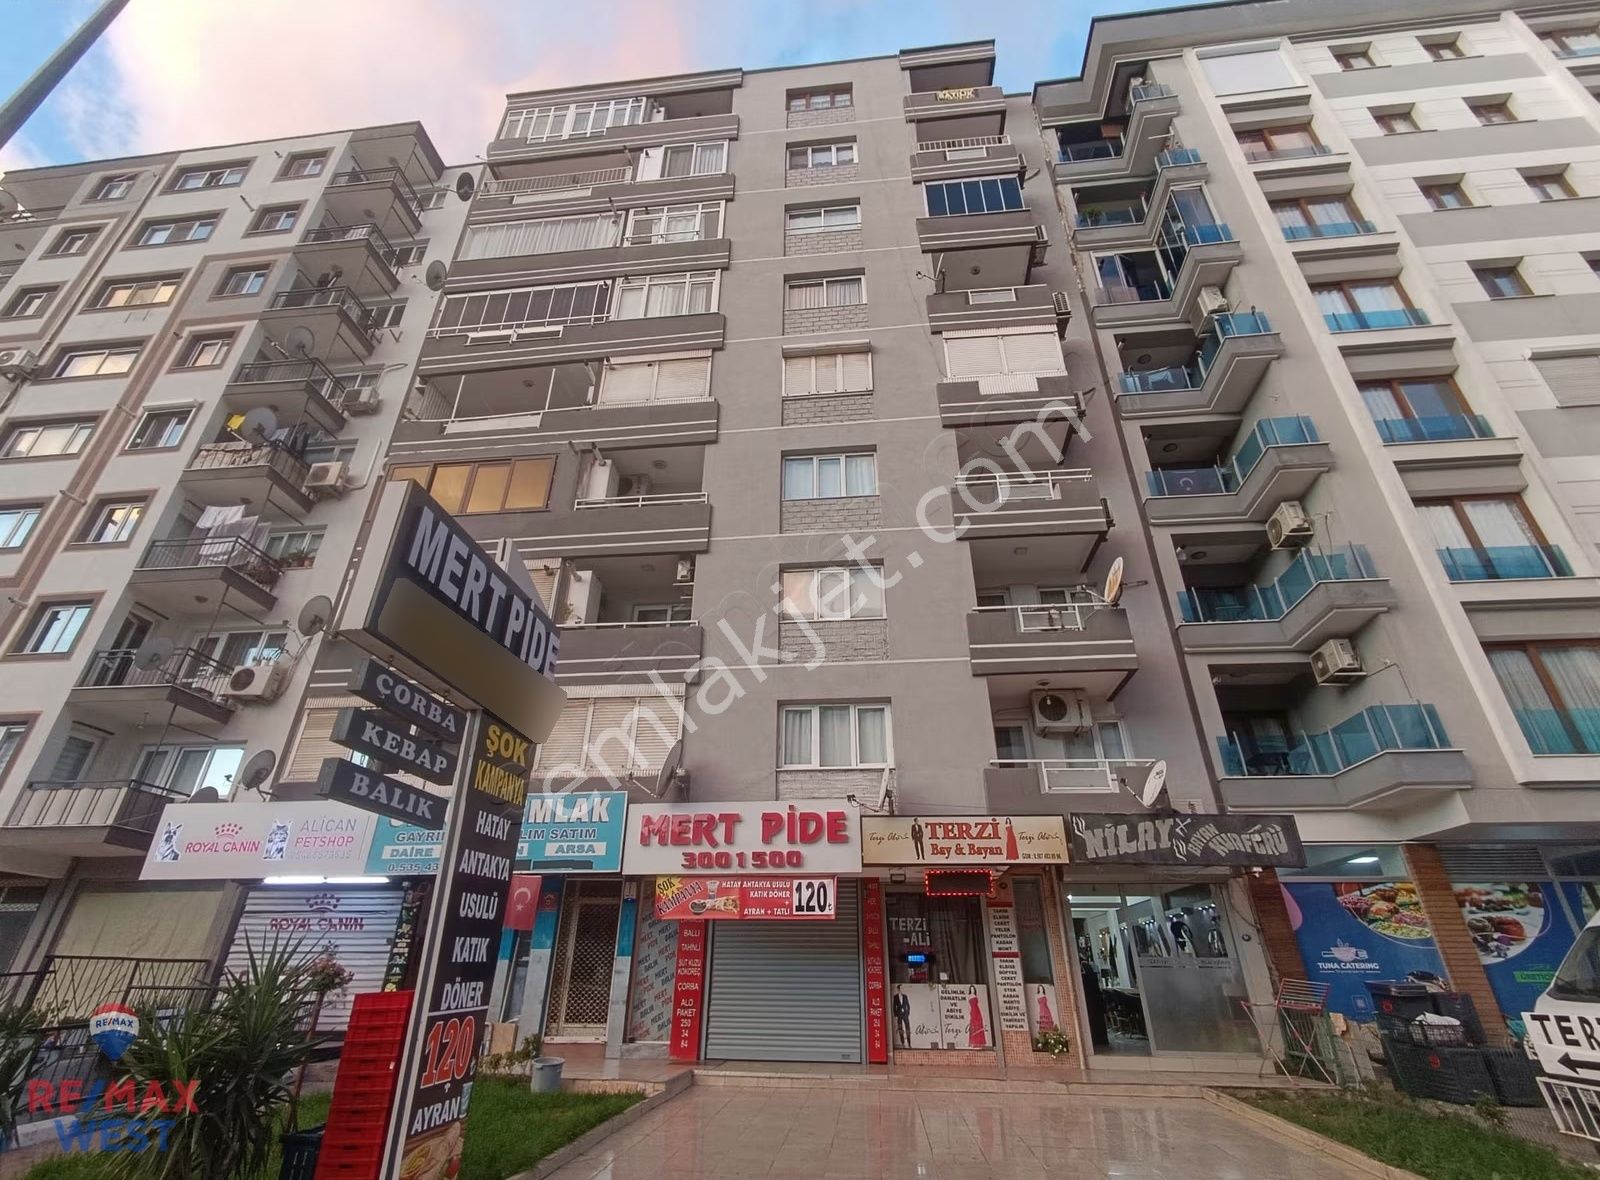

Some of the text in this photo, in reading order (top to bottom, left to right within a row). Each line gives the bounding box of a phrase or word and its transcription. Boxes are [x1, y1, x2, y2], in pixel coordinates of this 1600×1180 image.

[408, 505, 507, 632] MERT
[376, 673, 456, 732] ÇORBA
[361, 721, 447, 773] KEBAP
[486, 724, 528, 767] ŞOK
[474, 759, 525, 806] KAMPANYA
[350, 773, 434, 820] BALIK
[300, 815, 357, 833] ALİCAN
[523, 797, 611, 825] MLAK
[476, 810, 511, 841] HATAY
[550, 828, 597, 839] SATIM
[639, 804, 849, 848] MERT PİDE
[925, 818, 1001, 840] TERZİ
[1083, 818, 1174, 859] NİLAY
[184, 841, 260, 853] ROYAL CANIN
[294, 836, 354, 847] PETSHOP
[390, 845, 433, 858] DAİRE
[555, 844, 596, 854] ARSA
[931, 843, 1003, 859] Bay & Bayan
[1187, 823, 1219, 857] BAYAN
[459, 849, 510, 881] ANTAKYA
[722, 880, 741, 888] HATAY
[743, 880, 771, 888] ANTAKYA
[768, 889, 791, 898] DÖNER
[459, 891, 498, 920] USULÜ
[656, 880, 703, 916] KAMPANYA
[773, 907, 790, 915] TATLI
[270, 917, 365, 931] ROYAL CANIN
[452, 936, 490, 963] KATIK
[440, 976, 484, 1011] DÖNER
[678, 982, 698, 991] ÇORBA
[676, 1008, 696, 1016] PAKET
[681, 998, 694, 1006] ALO
[411, 1096, 461, 1135] AYRAN
